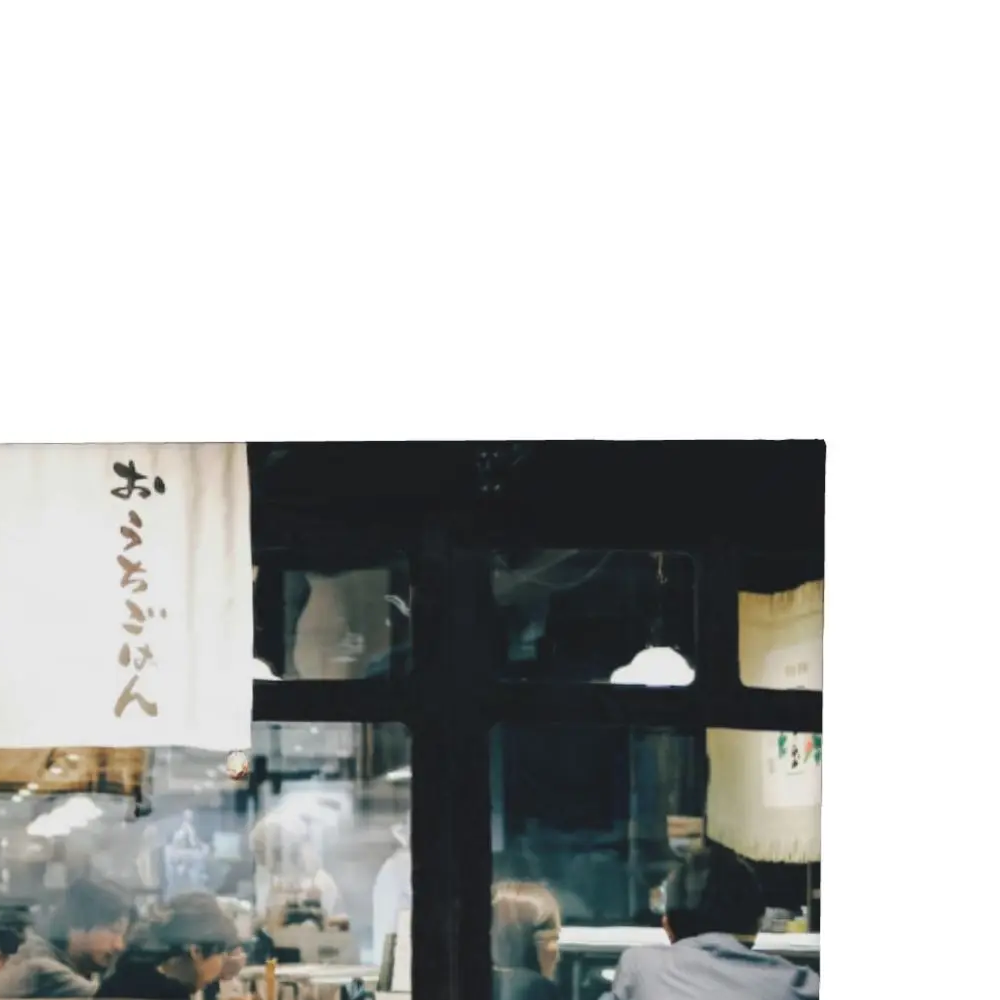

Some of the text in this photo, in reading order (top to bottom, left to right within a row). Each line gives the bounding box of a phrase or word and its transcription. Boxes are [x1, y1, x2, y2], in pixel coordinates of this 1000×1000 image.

[110, 460, 167, 717] おうちごはん
